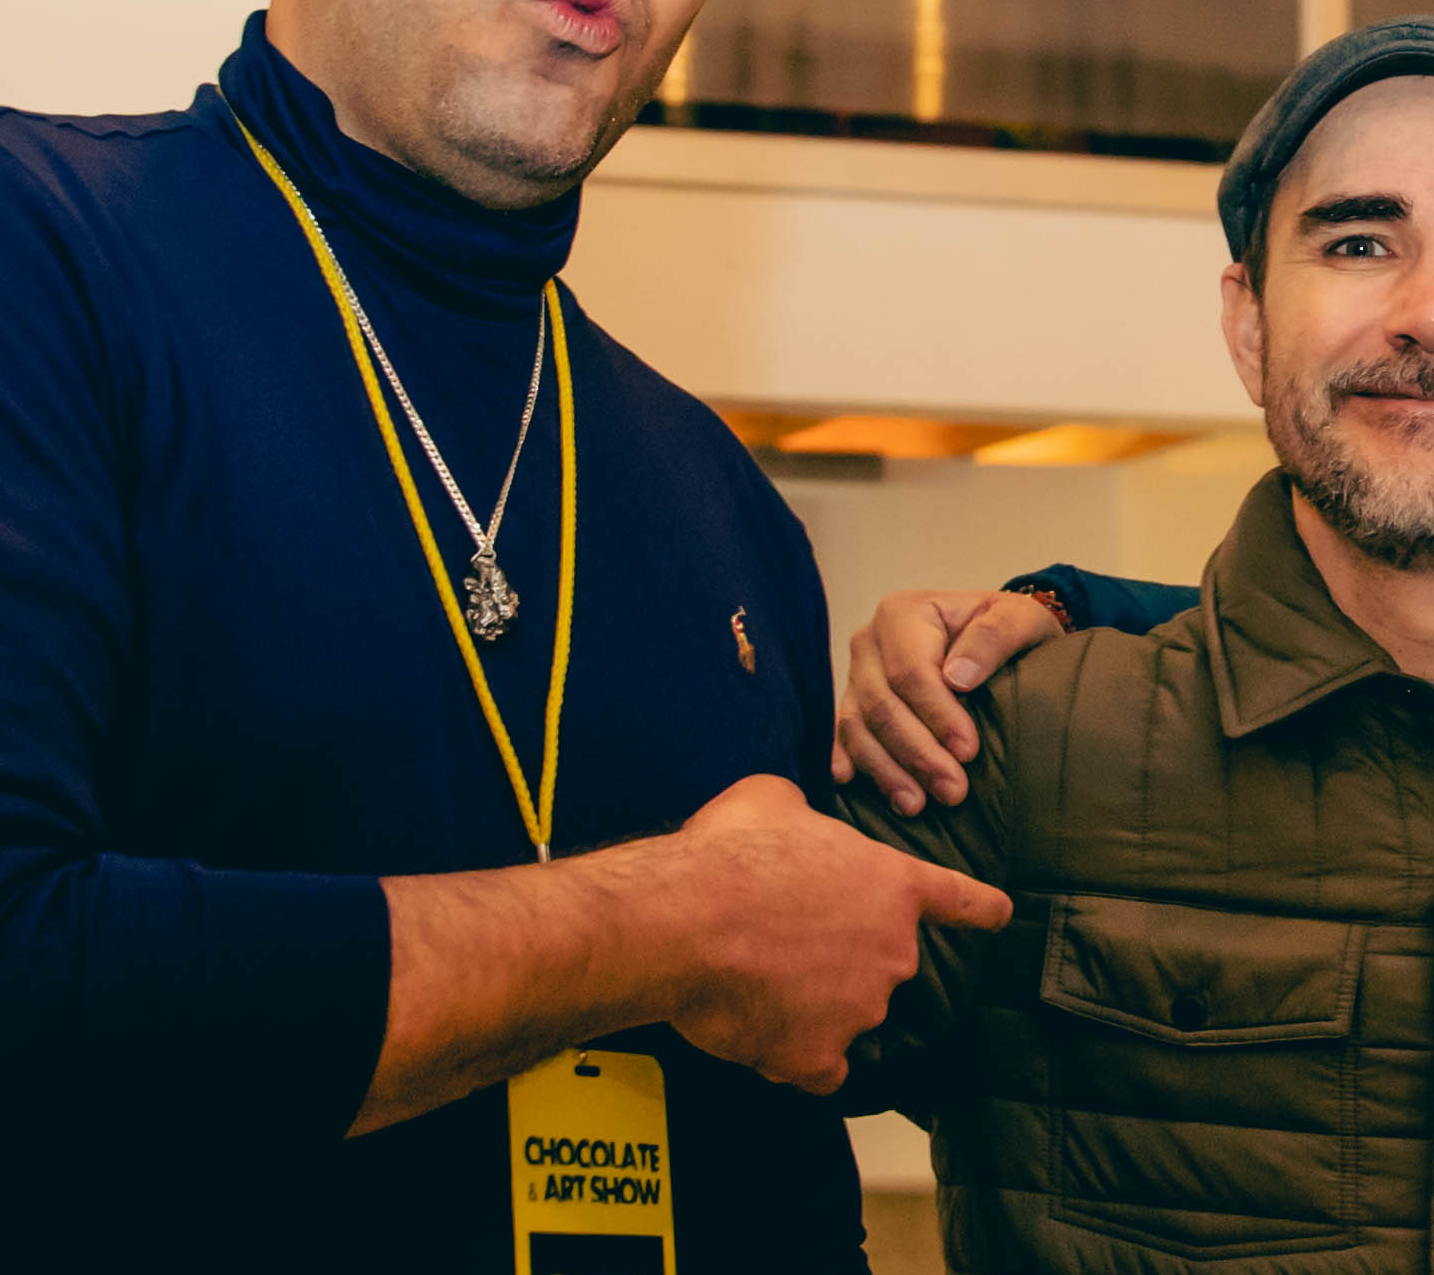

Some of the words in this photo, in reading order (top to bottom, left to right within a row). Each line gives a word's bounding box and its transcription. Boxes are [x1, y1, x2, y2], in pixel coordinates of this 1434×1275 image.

[525, 1136, 660, 1172] CHOCOLATE
[545, 1174, 586, 1203] ART
[590, 1176, 661, 1205] SHOW
